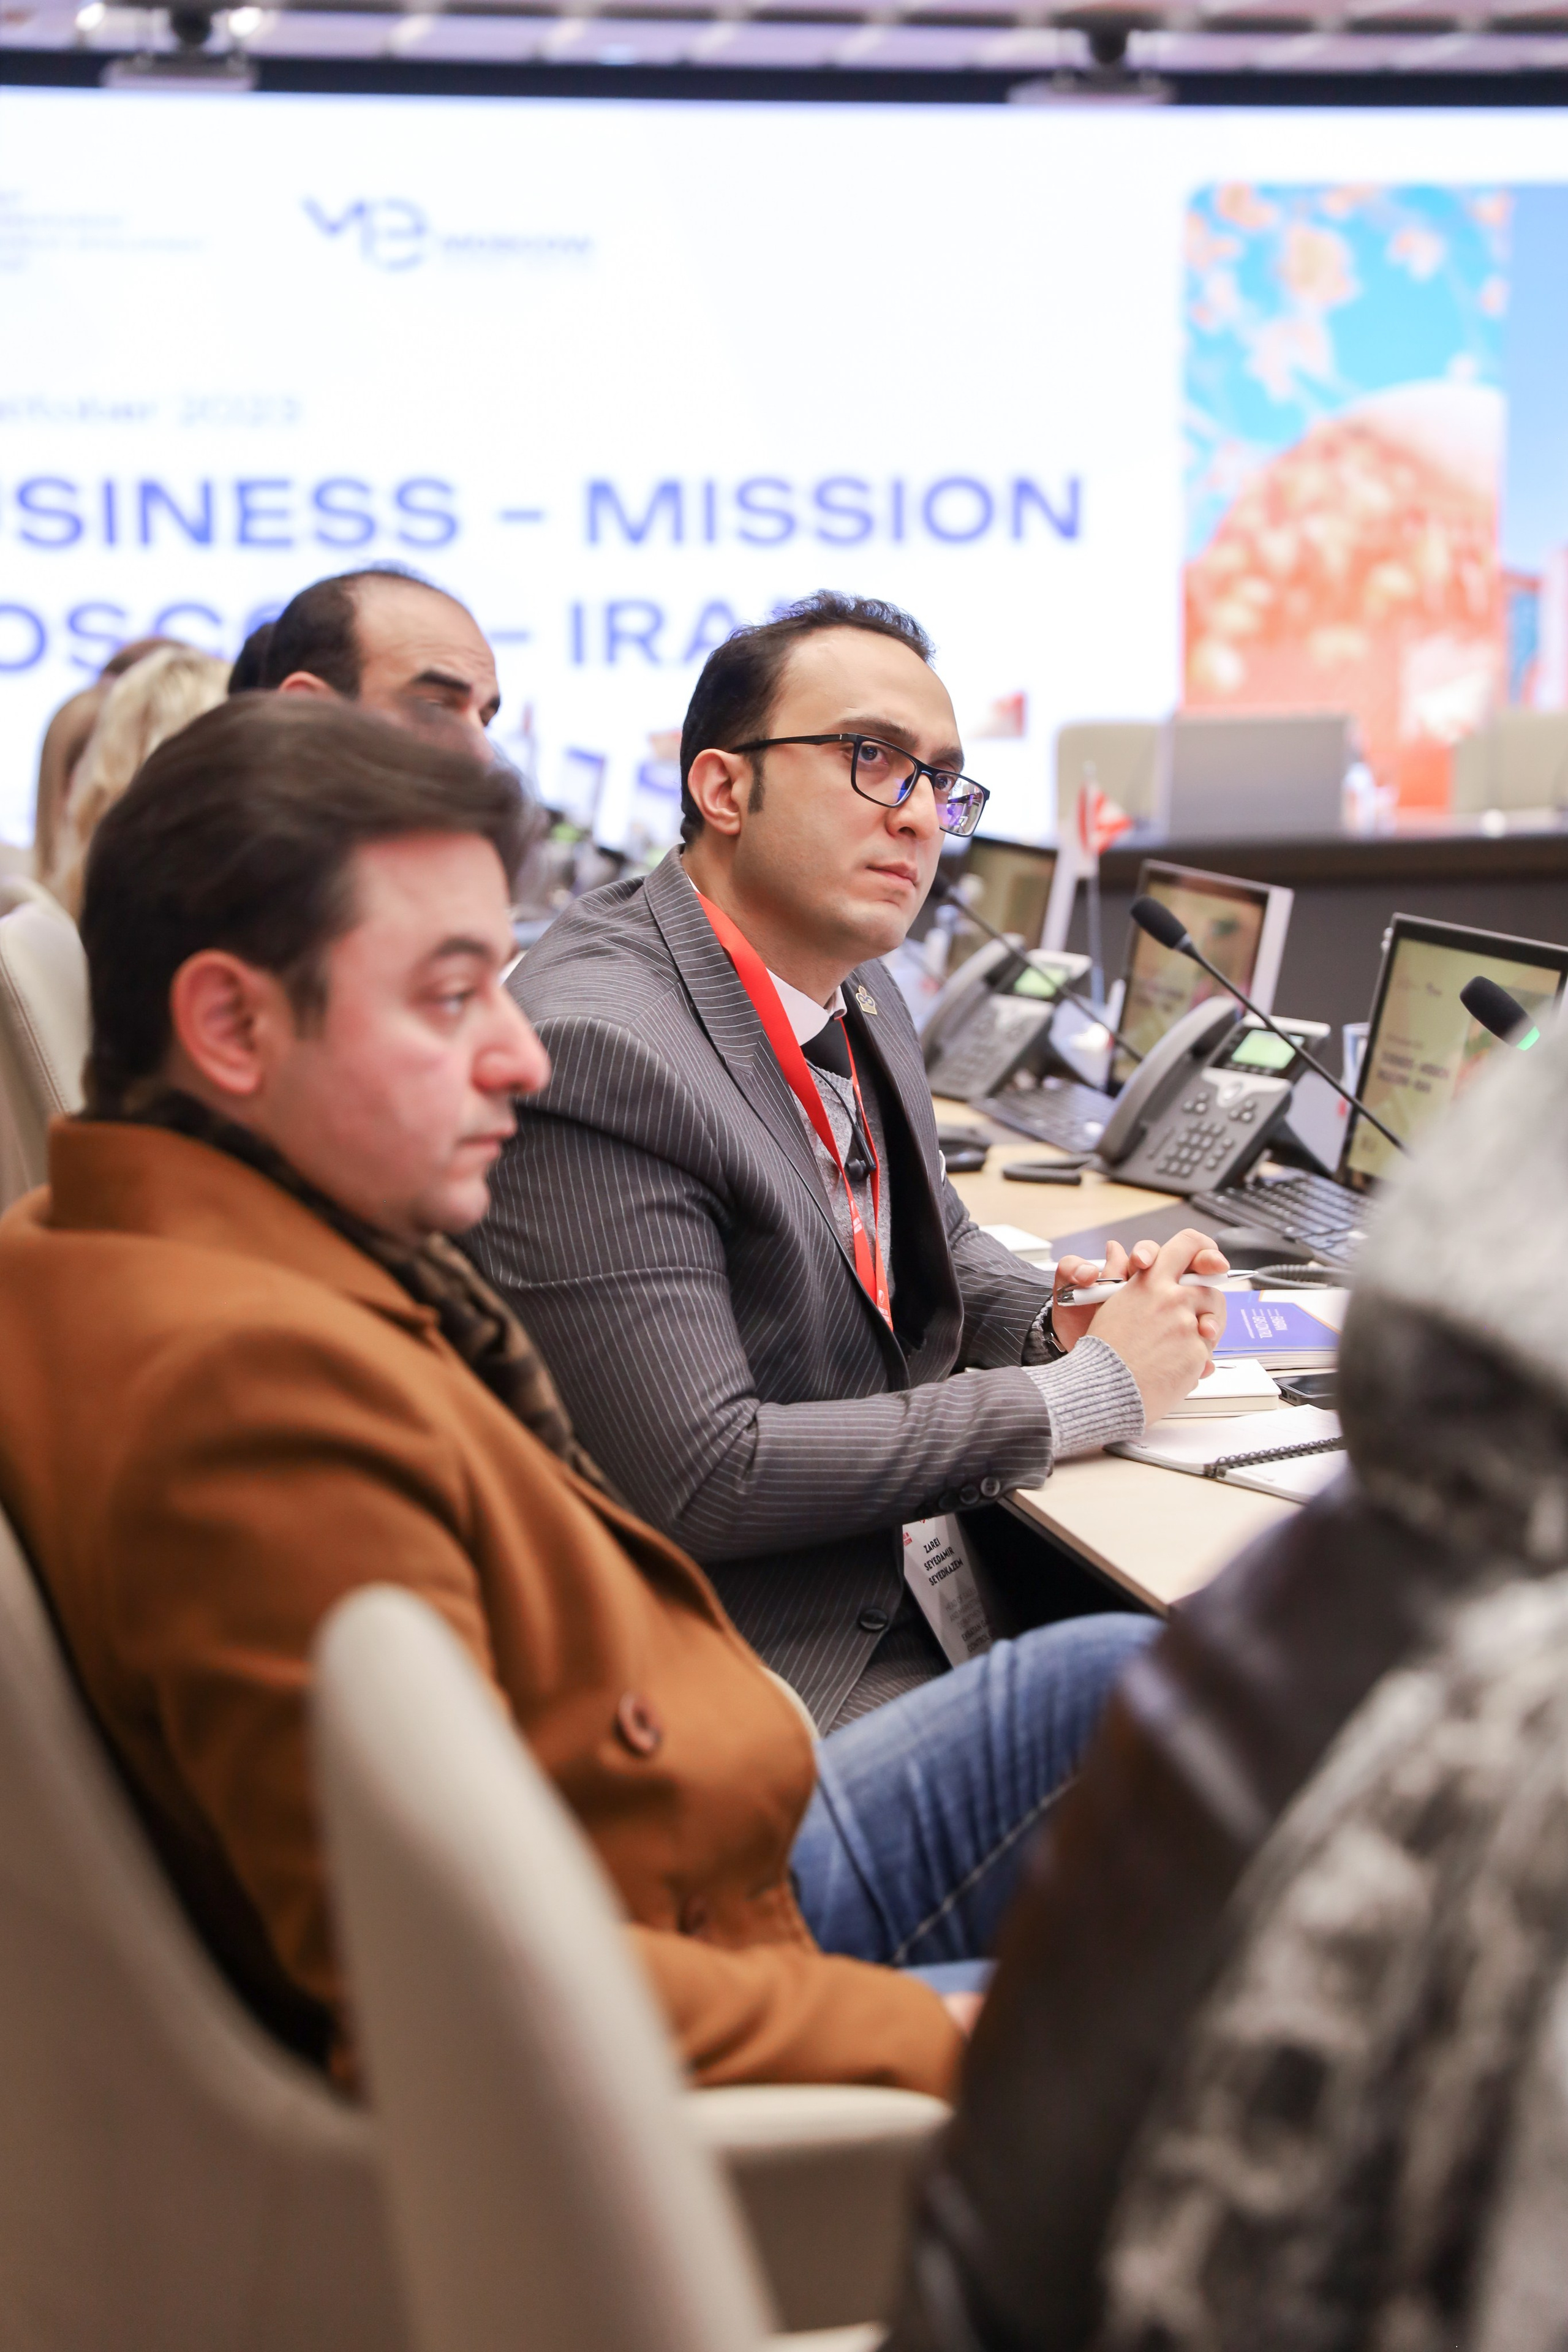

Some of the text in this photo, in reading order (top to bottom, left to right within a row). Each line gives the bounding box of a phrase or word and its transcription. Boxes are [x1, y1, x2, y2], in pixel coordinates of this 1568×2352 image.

[0, 475, 460, 549] SINESS
[584, 473, 1082, 548] MISSION
[569, 598, 790, 667] IRA
[923, 1537, 941, 1554] ZAREI
[924, 1546, 955, 1571] SEYEDAMIR
[929, 1558, 963, 1586] SEYEDKAZEM
